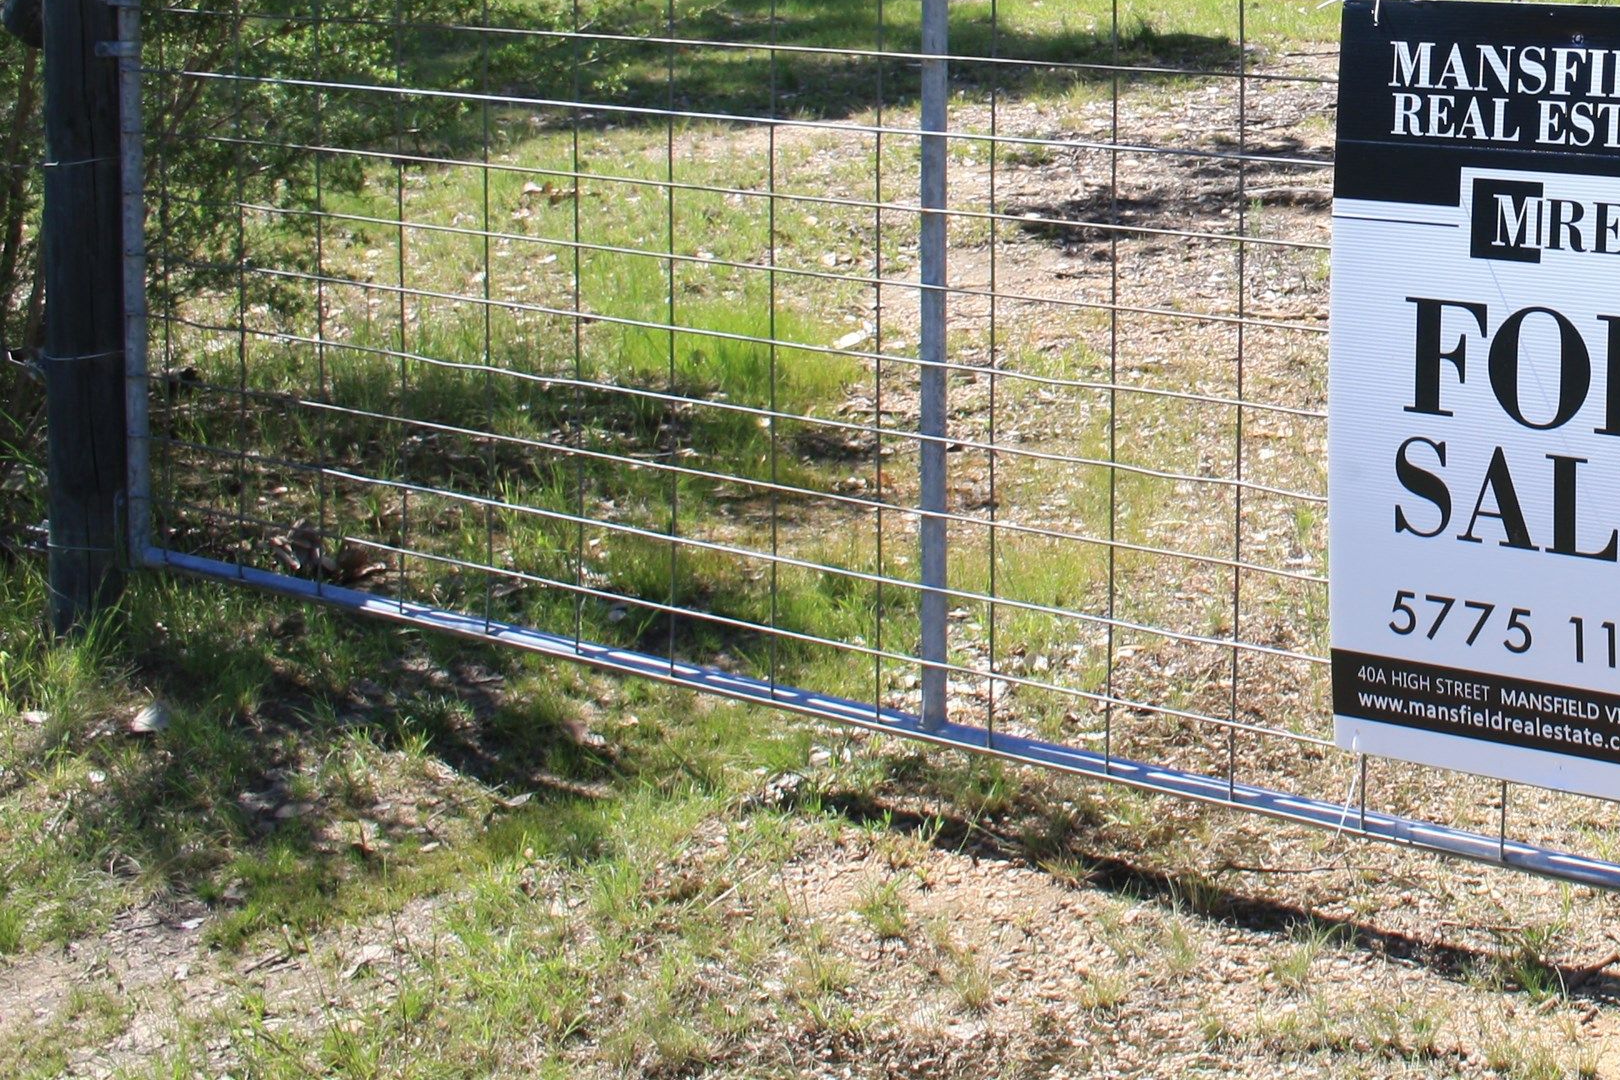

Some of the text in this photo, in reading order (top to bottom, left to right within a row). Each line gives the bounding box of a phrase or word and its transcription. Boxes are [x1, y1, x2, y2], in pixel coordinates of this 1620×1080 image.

[1390, 92, 1520, 142] REAL
[1388, 589, 1533, 654] 5775
[1357, 665, 1387, 685] 40A
[1391, 670, 1431, 692] HIGH
[1435, 677, 1490, 702] STREET
[1500, 688, 1600, 720] MANSFIELD
